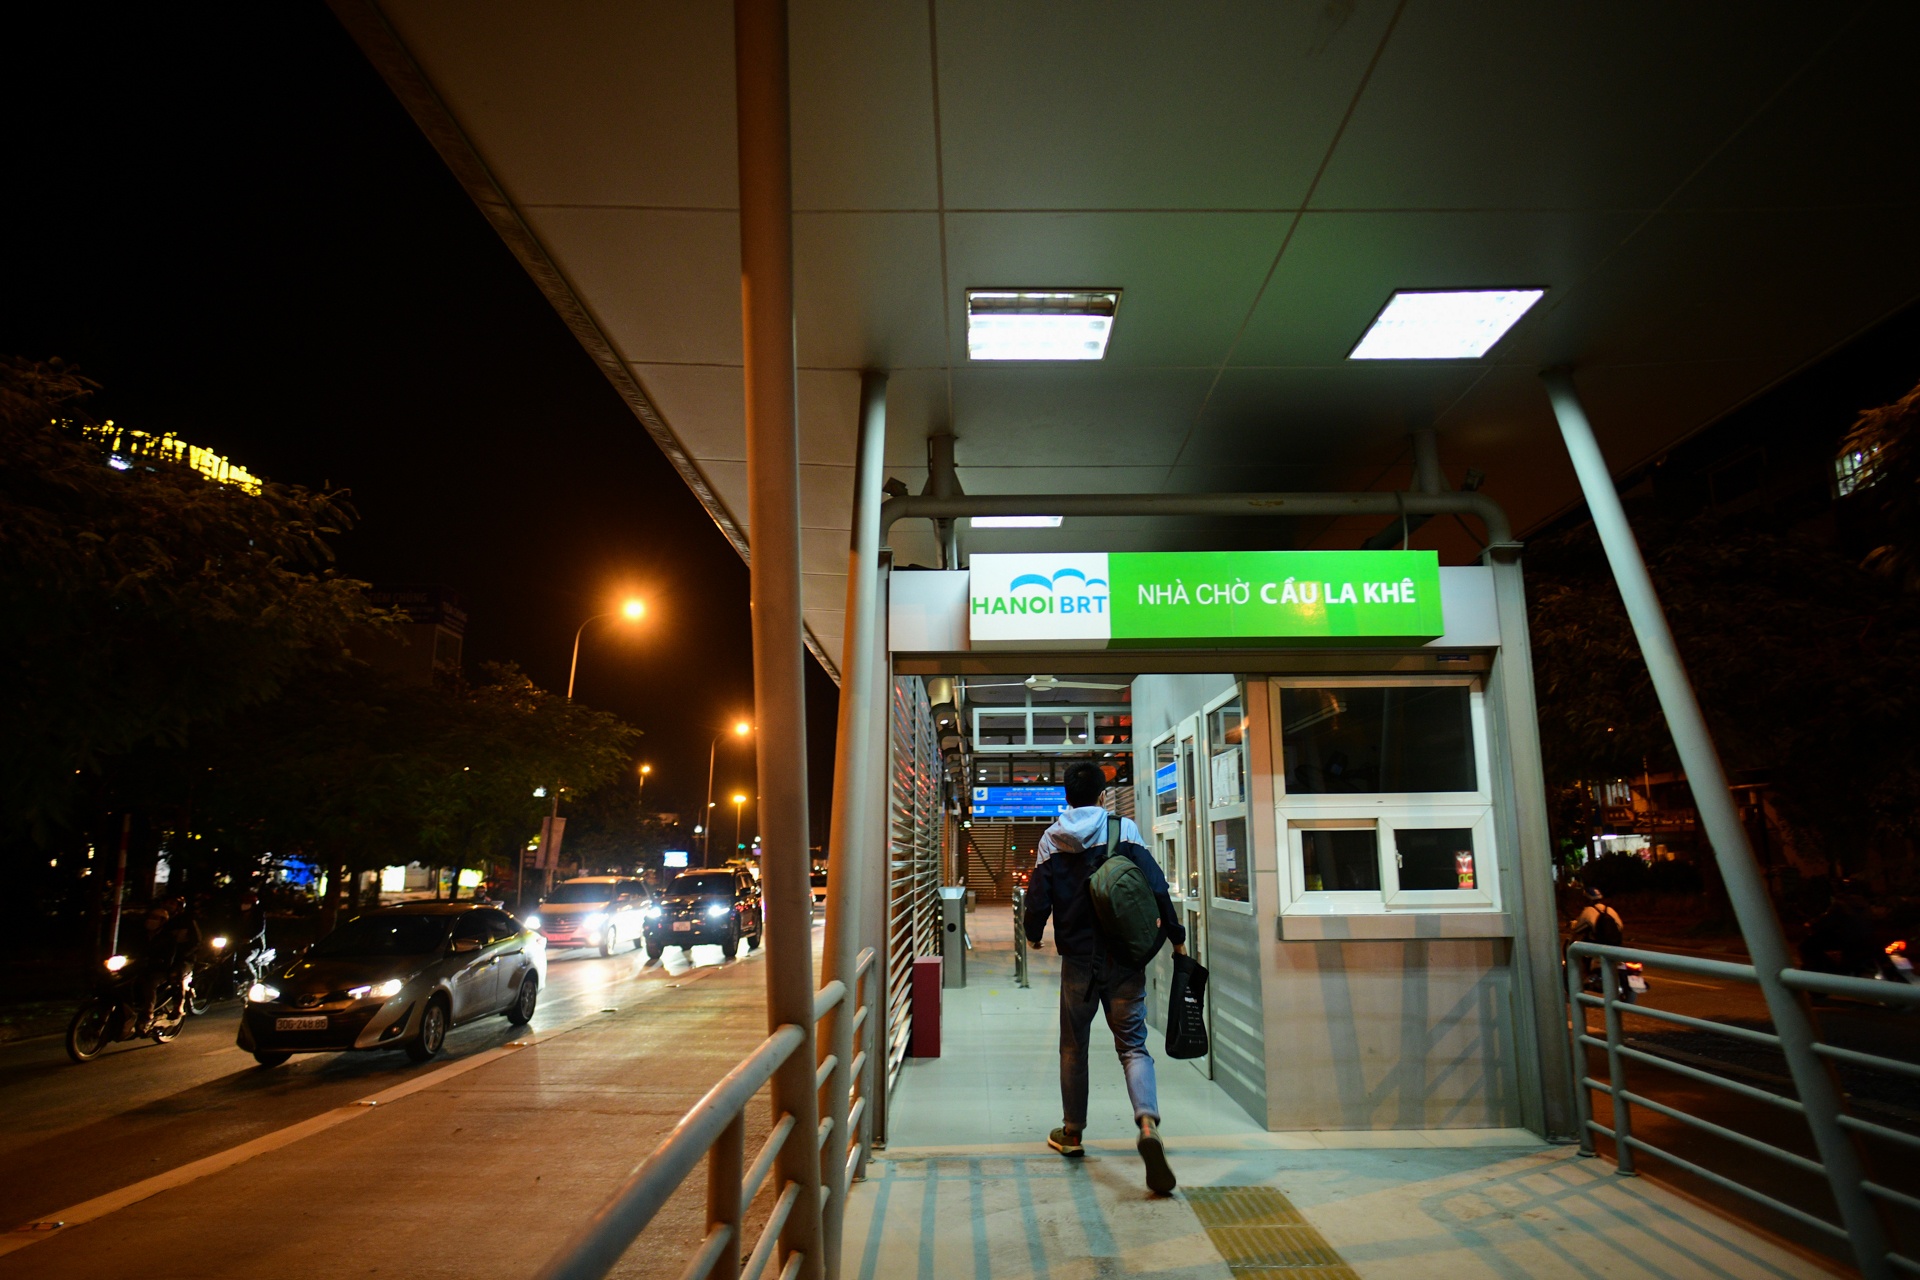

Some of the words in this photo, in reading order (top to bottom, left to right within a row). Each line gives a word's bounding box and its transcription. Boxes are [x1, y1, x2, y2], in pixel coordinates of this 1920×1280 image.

[1138, 578, 1190, 605] NHÀ
[1196, 578, 1250, 605] CHỜ
[1260, 577, 1317, 604] CẦU
[1324, 583, 1358, 604] LA
[1363, 577, 1416, 604] KHÊ
[972, 596, 1053, 614] HANOI
[1060, 596, 1107, 613] BRT
